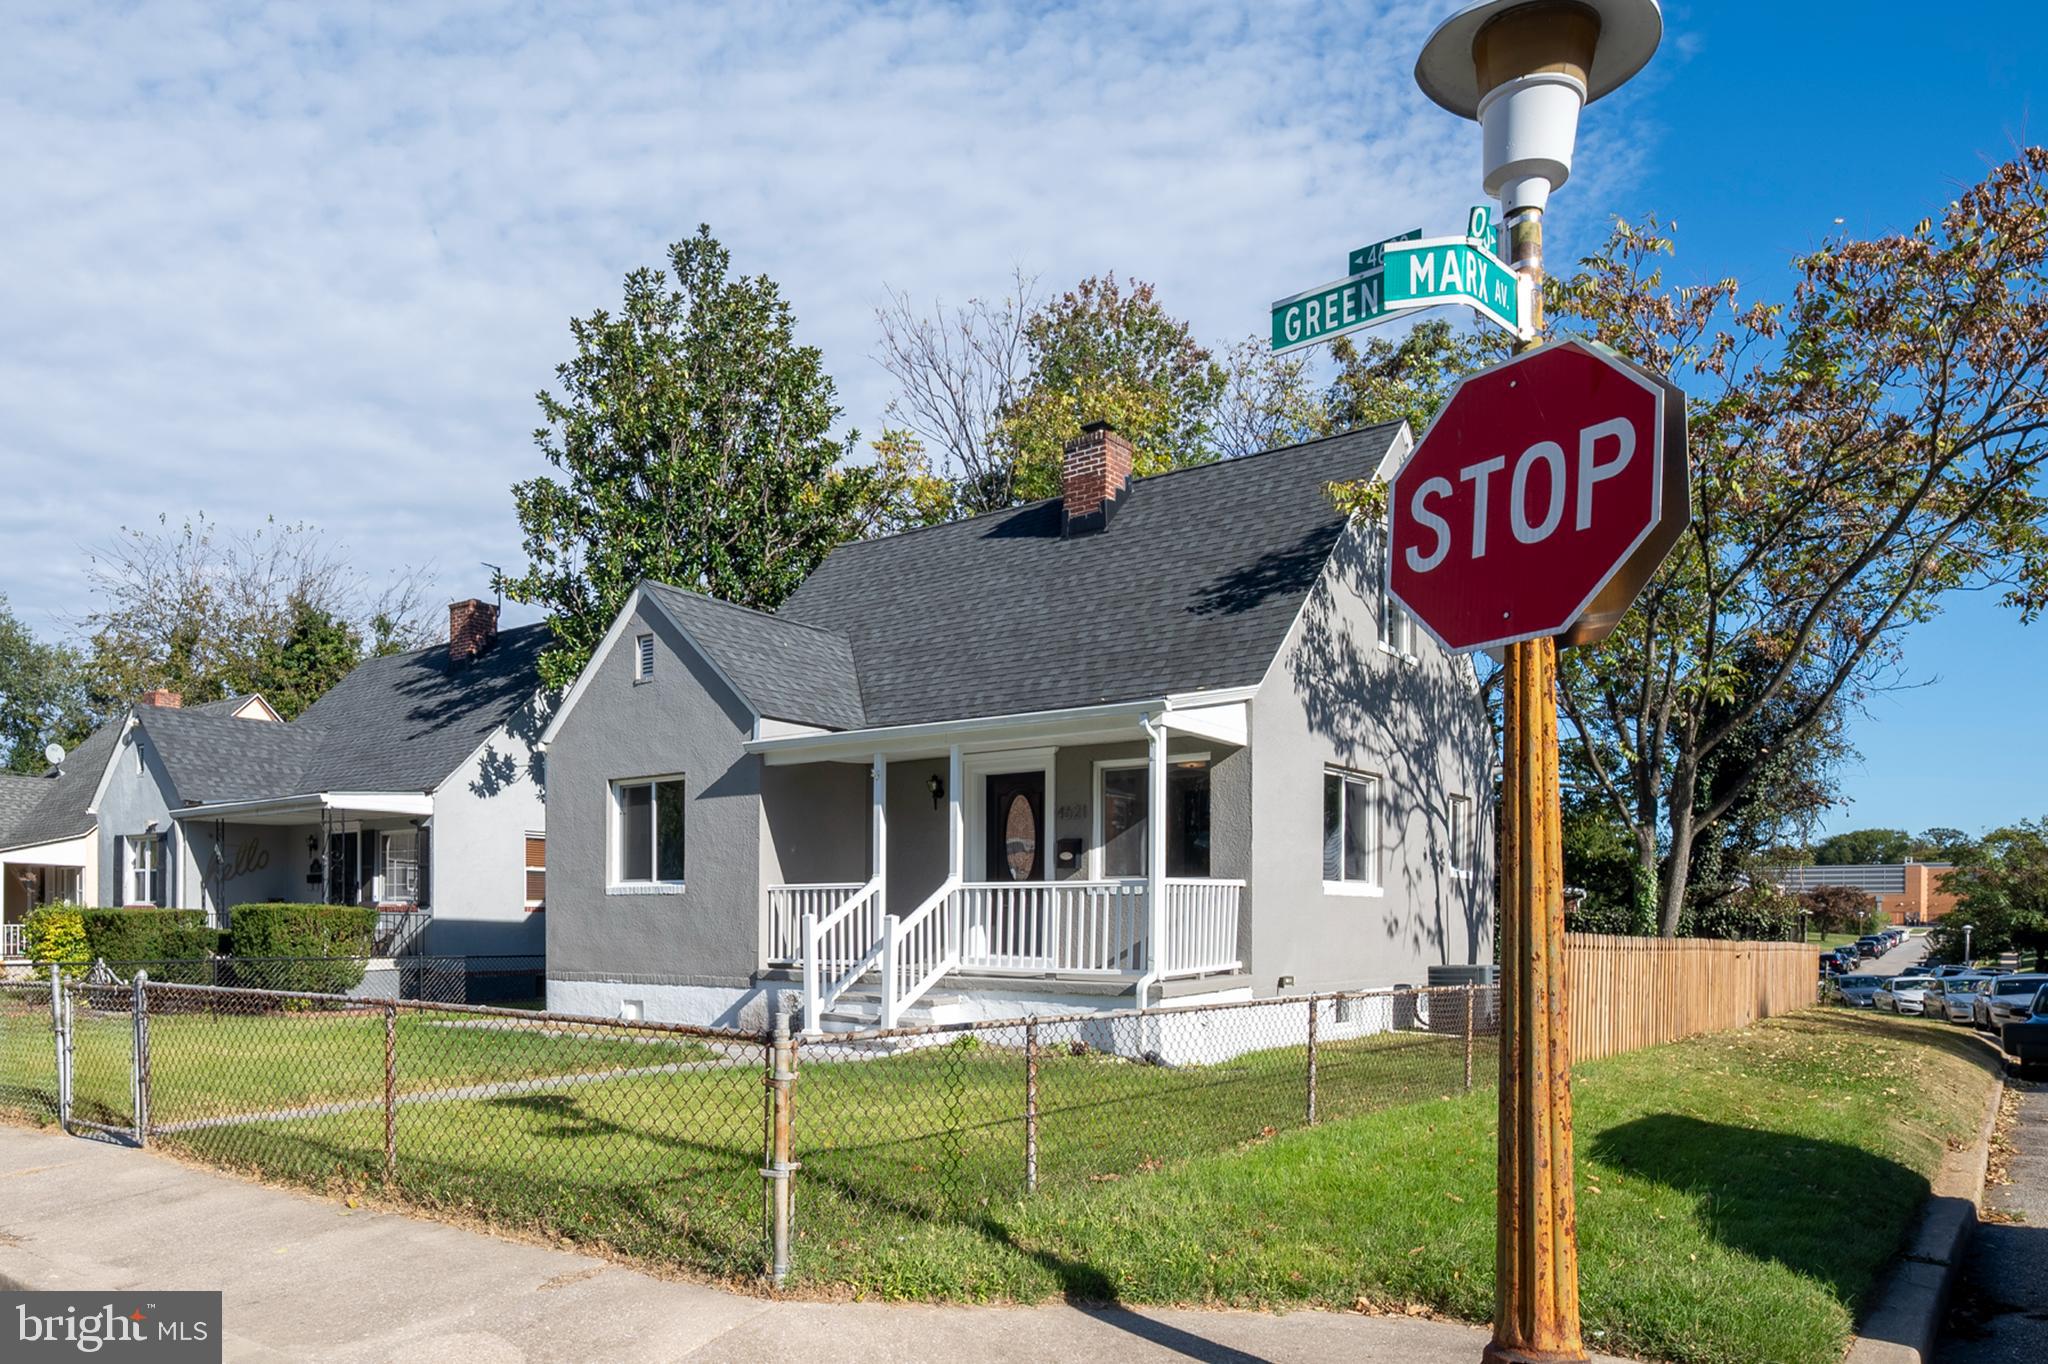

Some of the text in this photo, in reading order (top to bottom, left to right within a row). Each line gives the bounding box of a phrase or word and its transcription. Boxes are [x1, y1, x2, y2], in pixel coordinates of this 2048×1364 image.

[1410, 250, 1488, 303] MARX
[1285, 279, 1378, 341] GREEN
[1405, 416, 1636, 573] STOP
